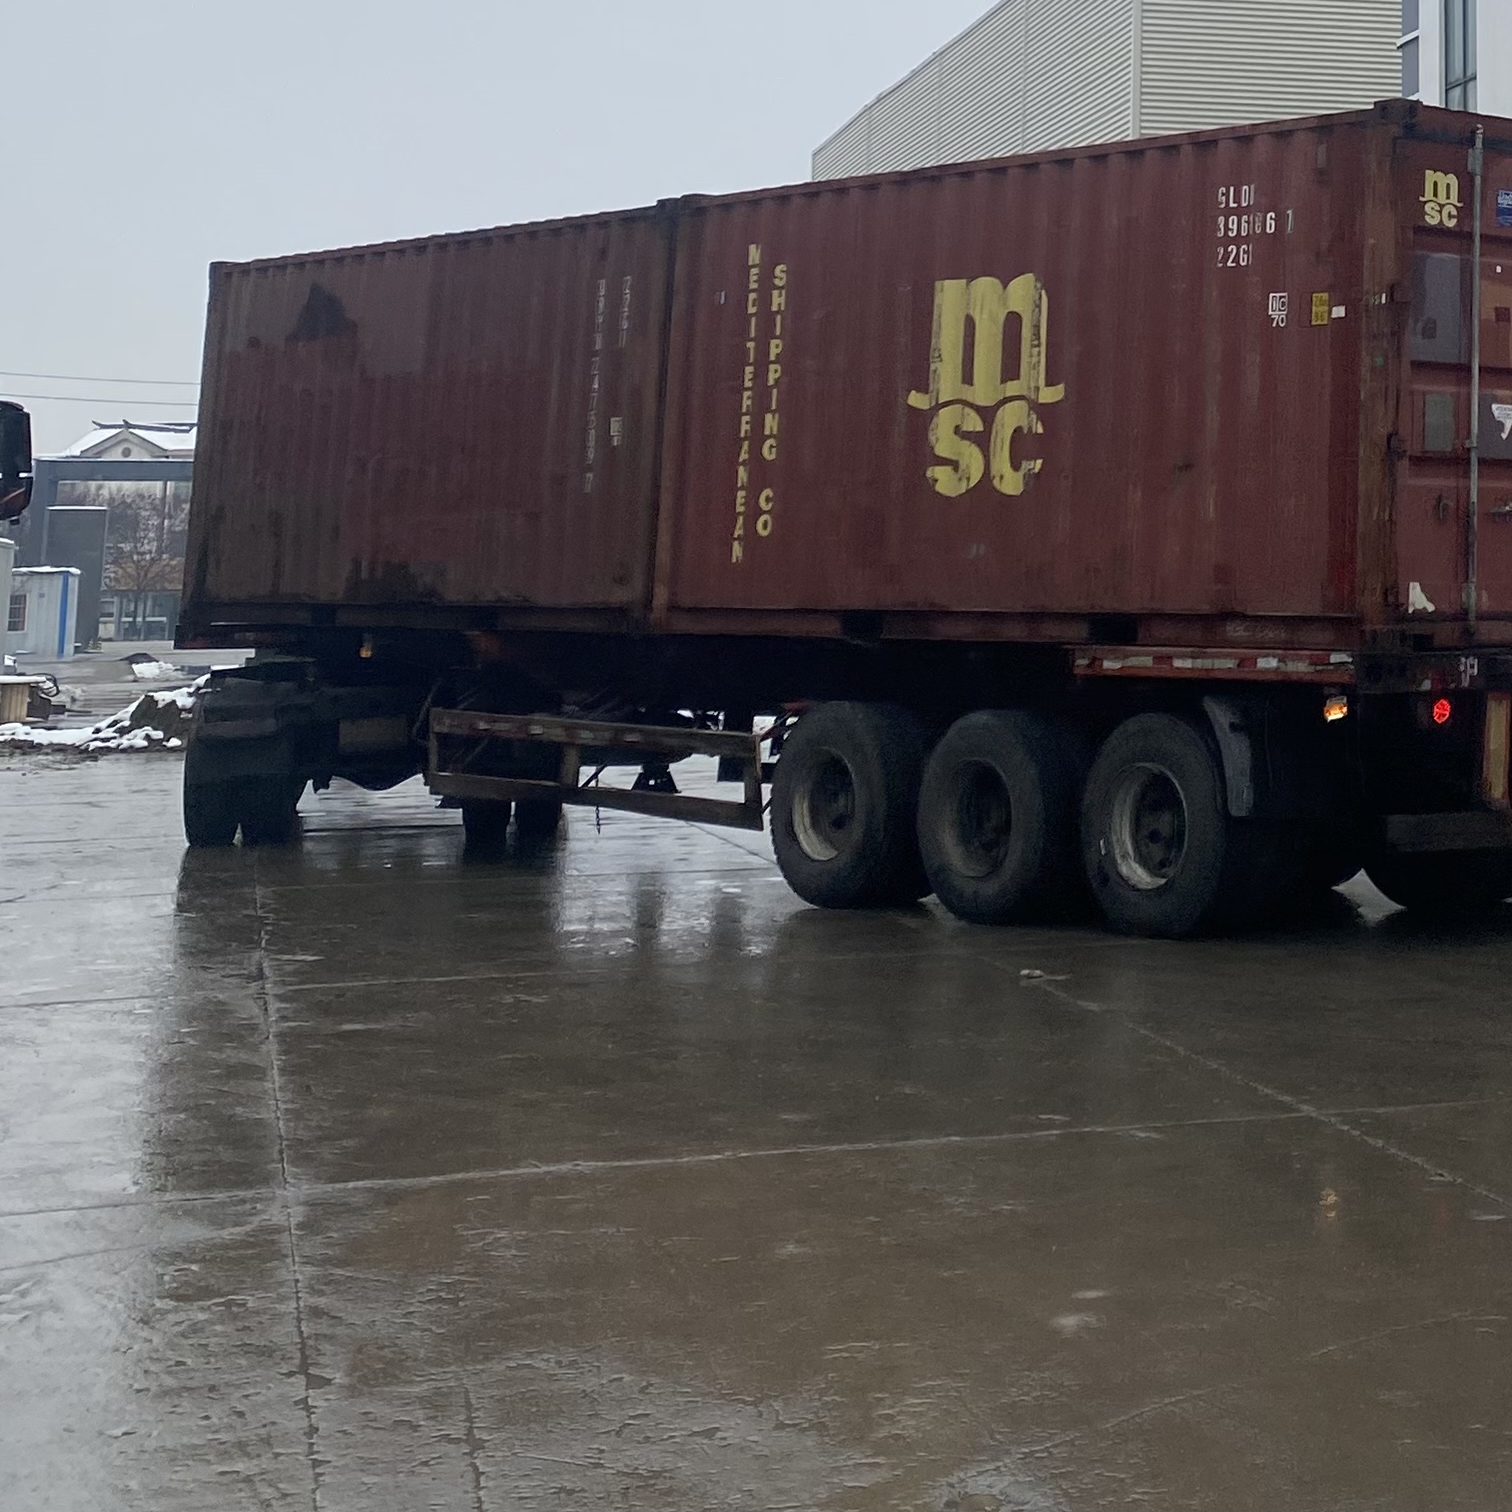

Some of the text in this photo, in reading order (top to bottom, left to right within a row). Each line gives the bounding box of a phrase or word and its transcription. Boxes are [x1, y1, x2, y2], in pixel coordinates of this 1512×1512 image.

[1271, 315, 1287, 328] 70
[755, 263, 788, 537] SHIPPING CO
